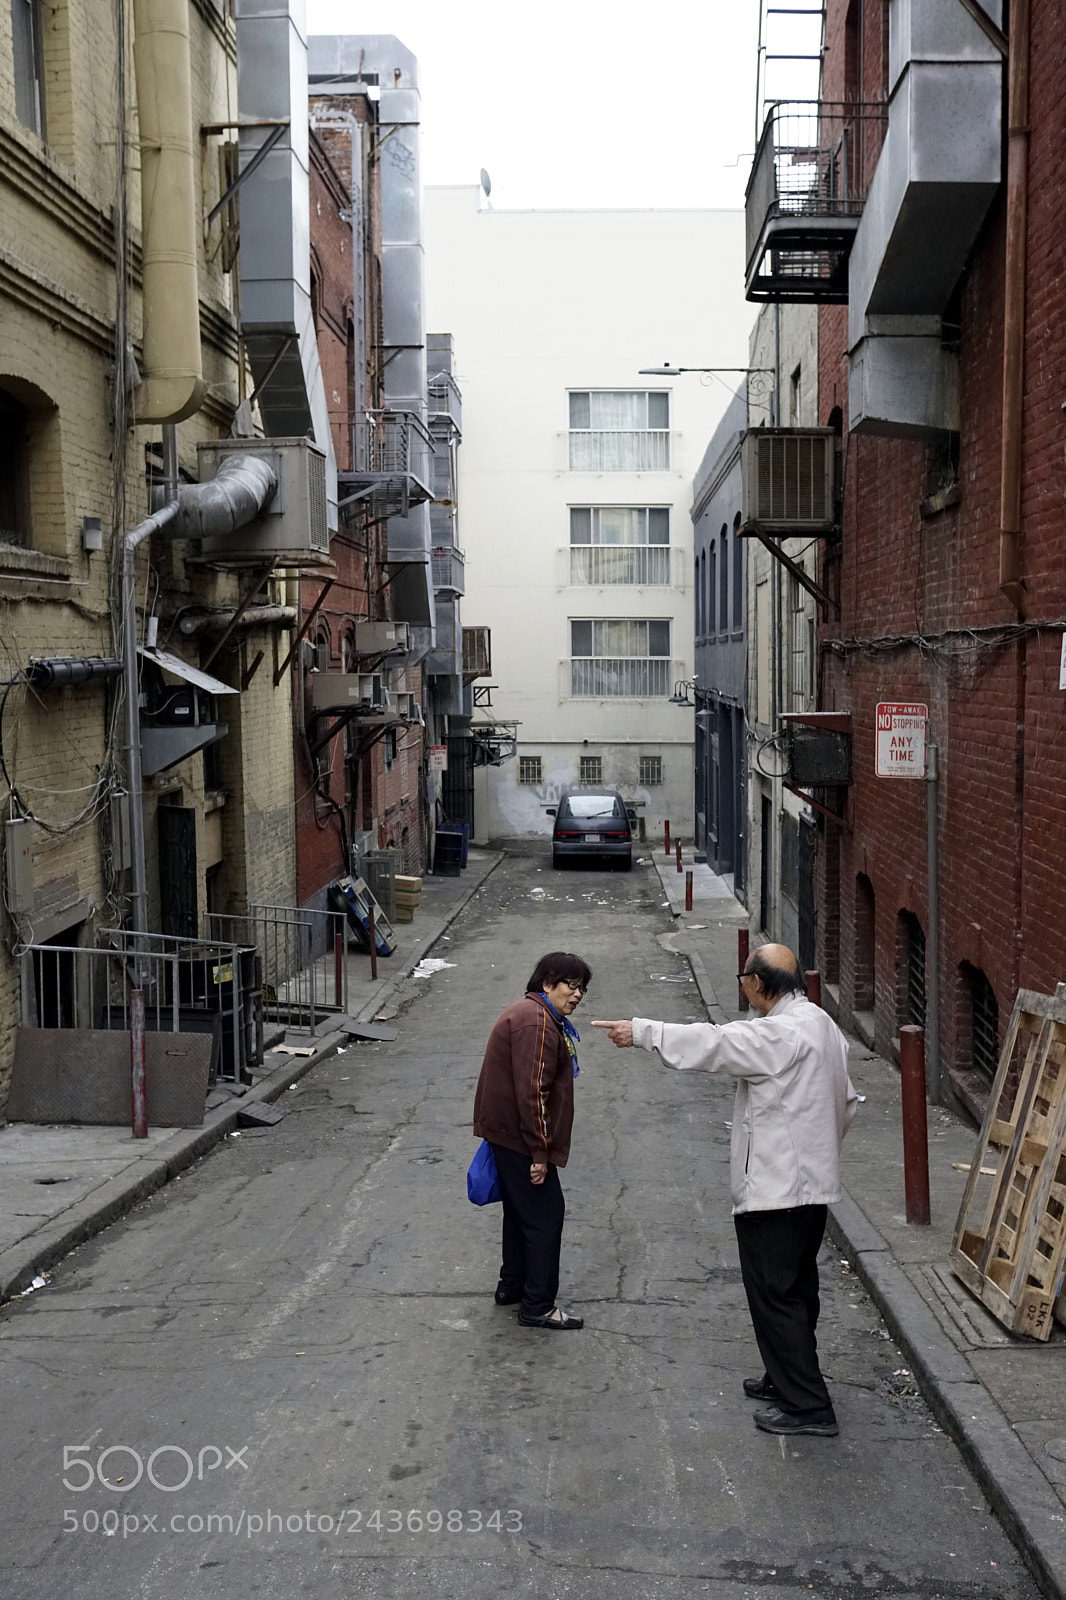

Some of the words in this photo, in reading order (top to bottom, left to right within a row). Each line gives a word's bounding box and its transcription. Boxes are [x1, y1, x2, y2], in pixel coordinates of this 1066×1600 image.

[878, 714, 891, 729] NO
[893, 718, 925, 730] STOPPING
[890, 736, 913, 748] ANY
[888, 750, 914, 762] TIME
[1035, 1301, 1049, 1327] LKK
